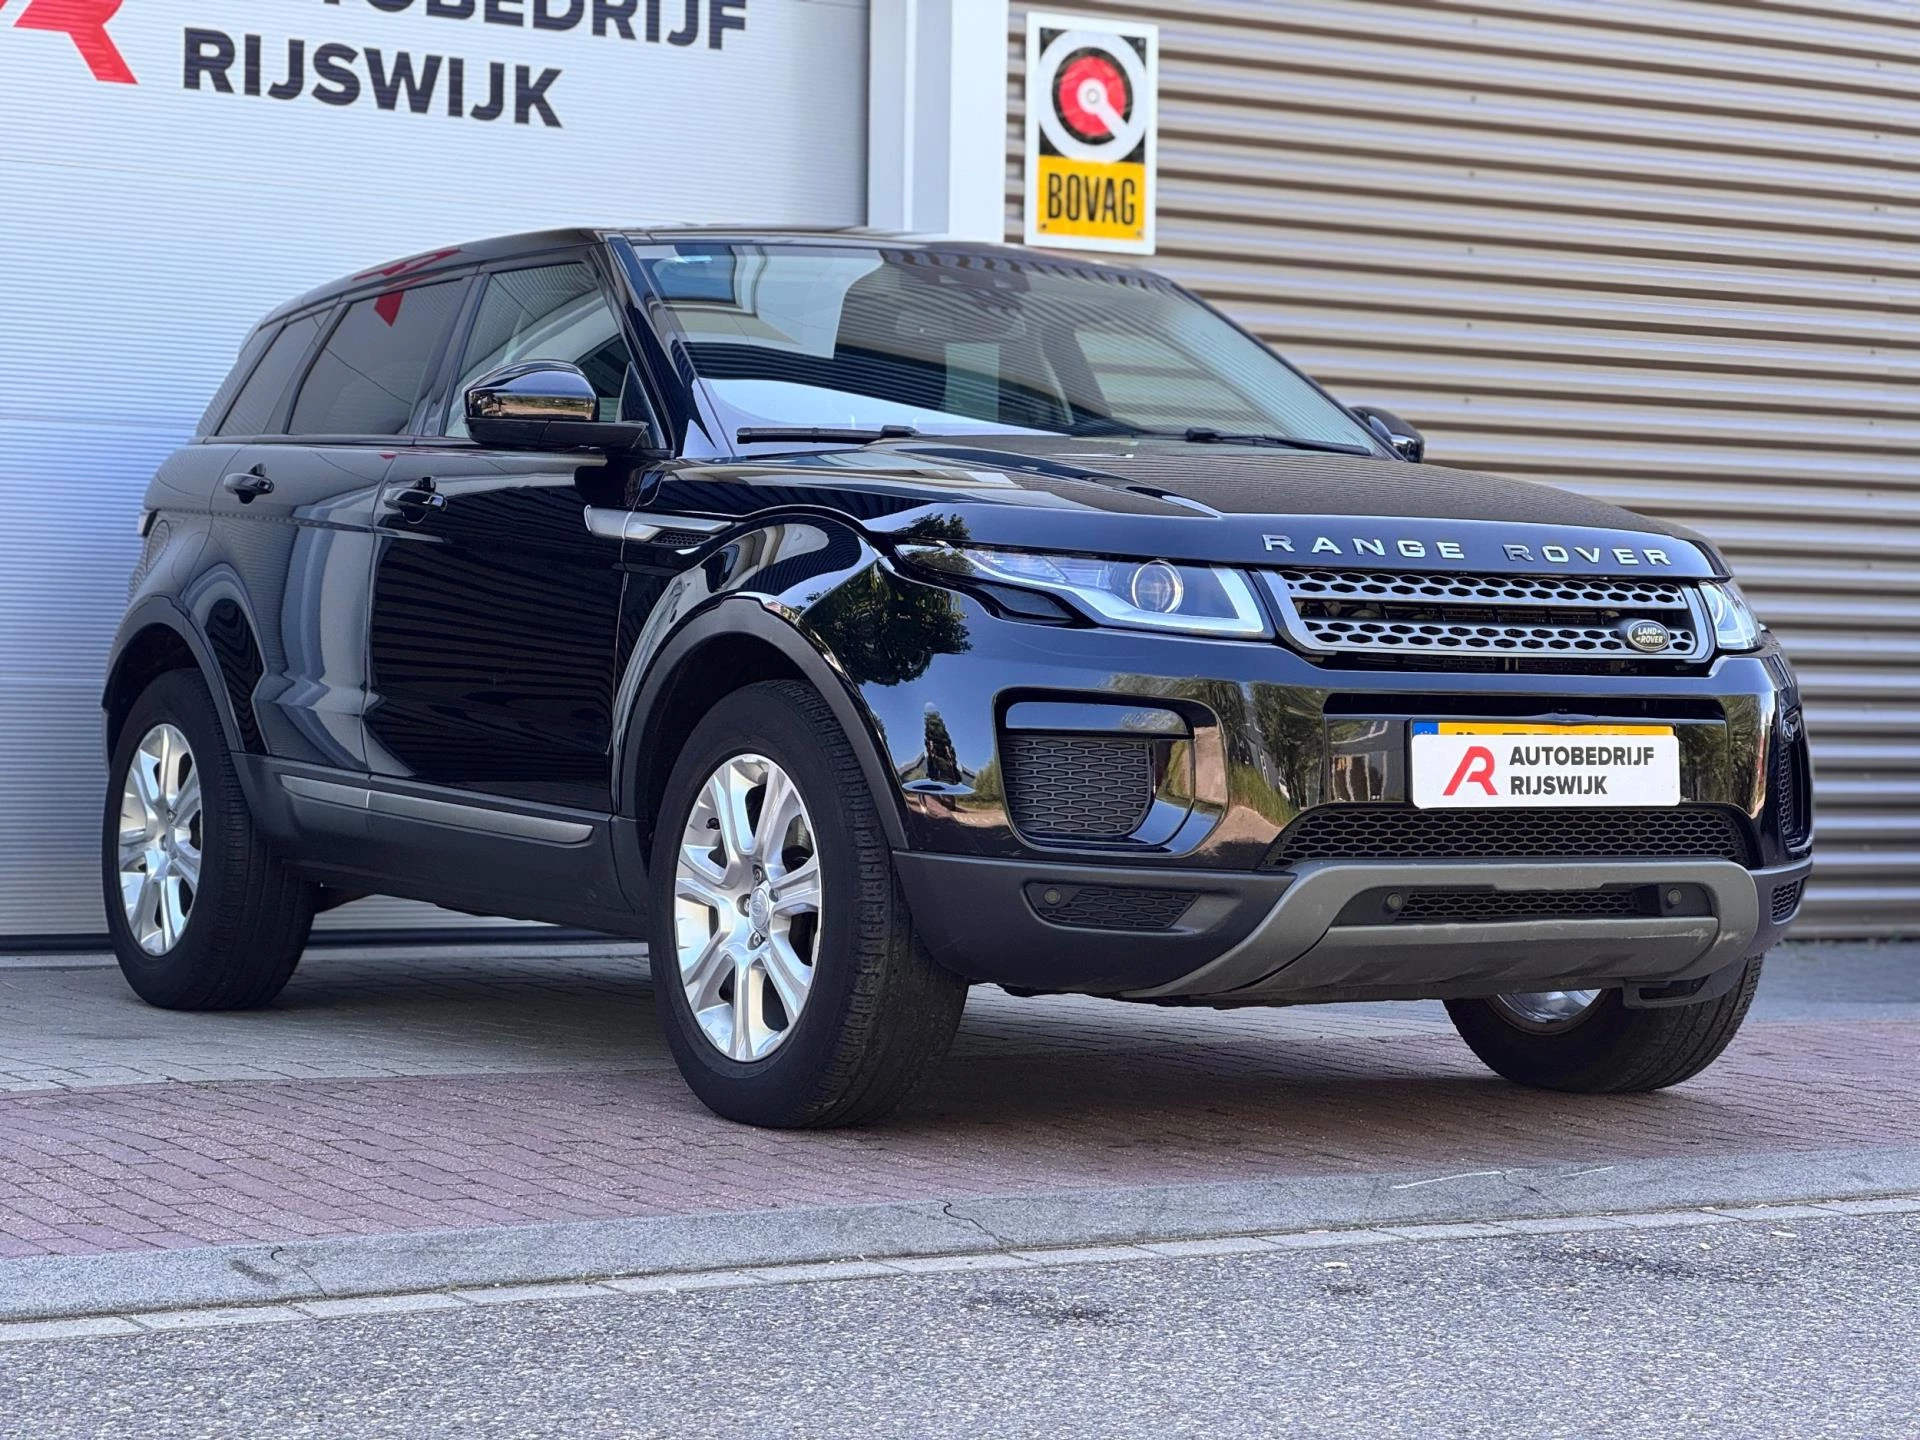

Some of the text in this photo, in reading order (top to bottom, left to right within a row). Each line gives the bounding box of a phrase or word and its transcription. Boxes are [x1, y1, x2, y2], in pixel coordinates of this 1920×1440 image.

[183, 27, 563, 128] RIJSWIJK
[1048, 173, 1136, 226] BOVAG
[1262, 533, 1672, 565] RANGE ROVER
[1638, 627, 1657, 635] LAND
[1641, 635, 1664, 644] ROVER
[1509, 746, 1655, 766] AUTOBEDRIJF
[1510, 775, 1608, 795] RIJSWIJK
